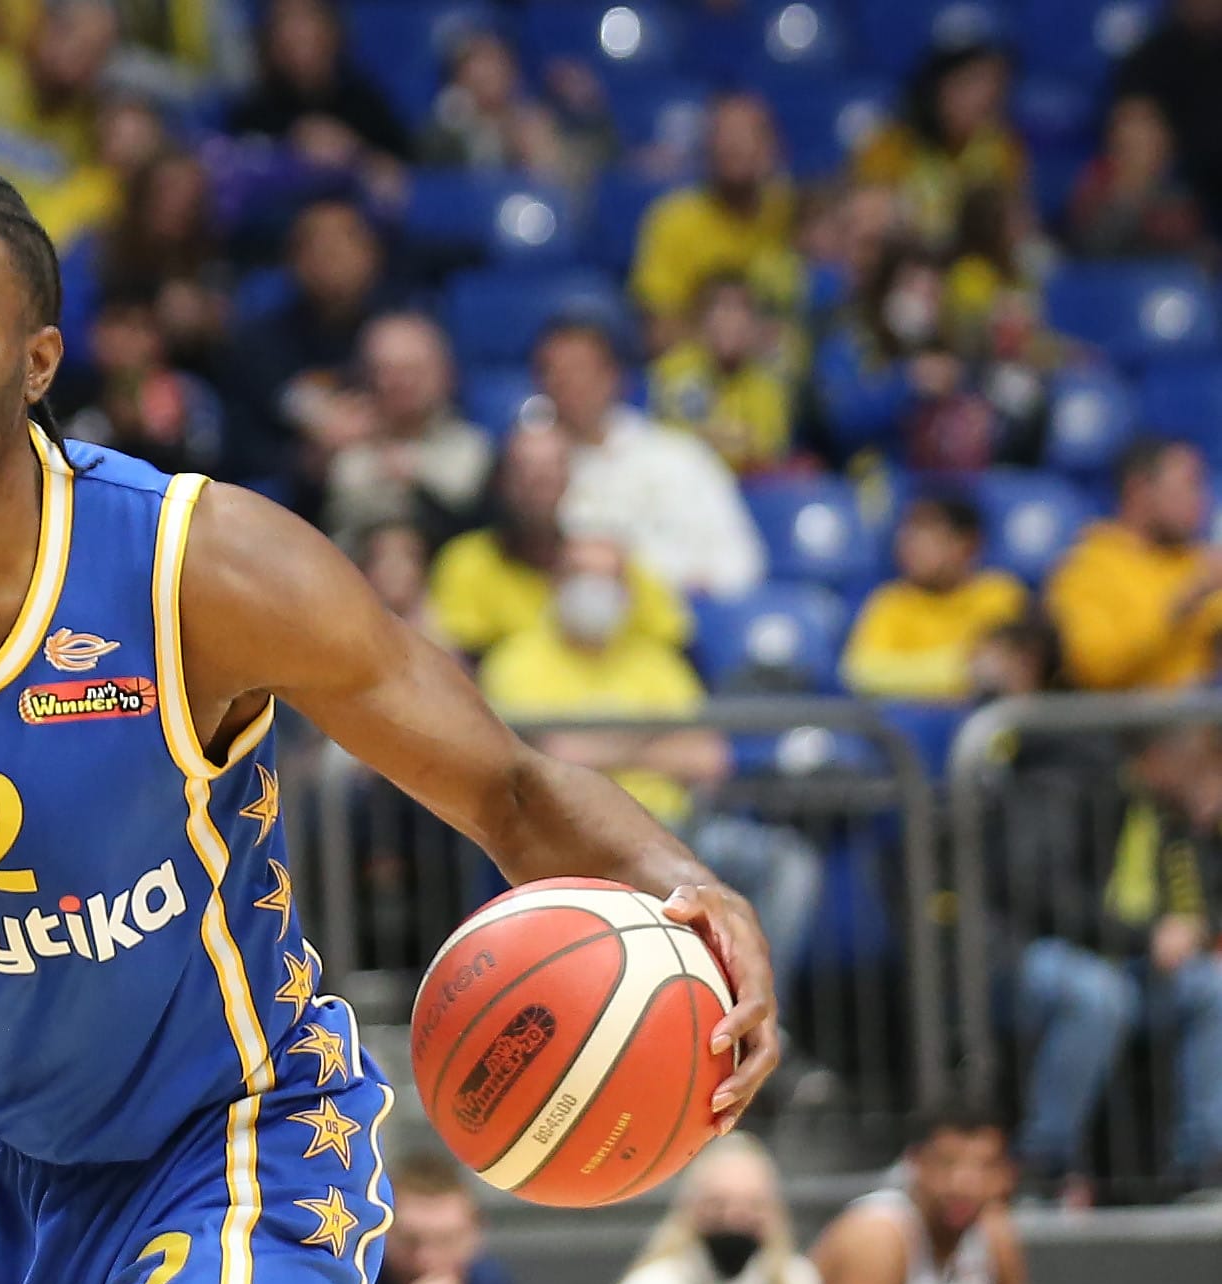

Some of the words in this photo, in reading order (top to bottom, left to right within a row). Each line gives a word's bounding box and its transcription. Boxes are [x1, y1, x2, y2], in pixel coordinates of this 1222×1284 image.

[87, 682, 117, 700] ליגת
[31, 694, 118, 716] Winner
[119, 692, 140, 709] סל
